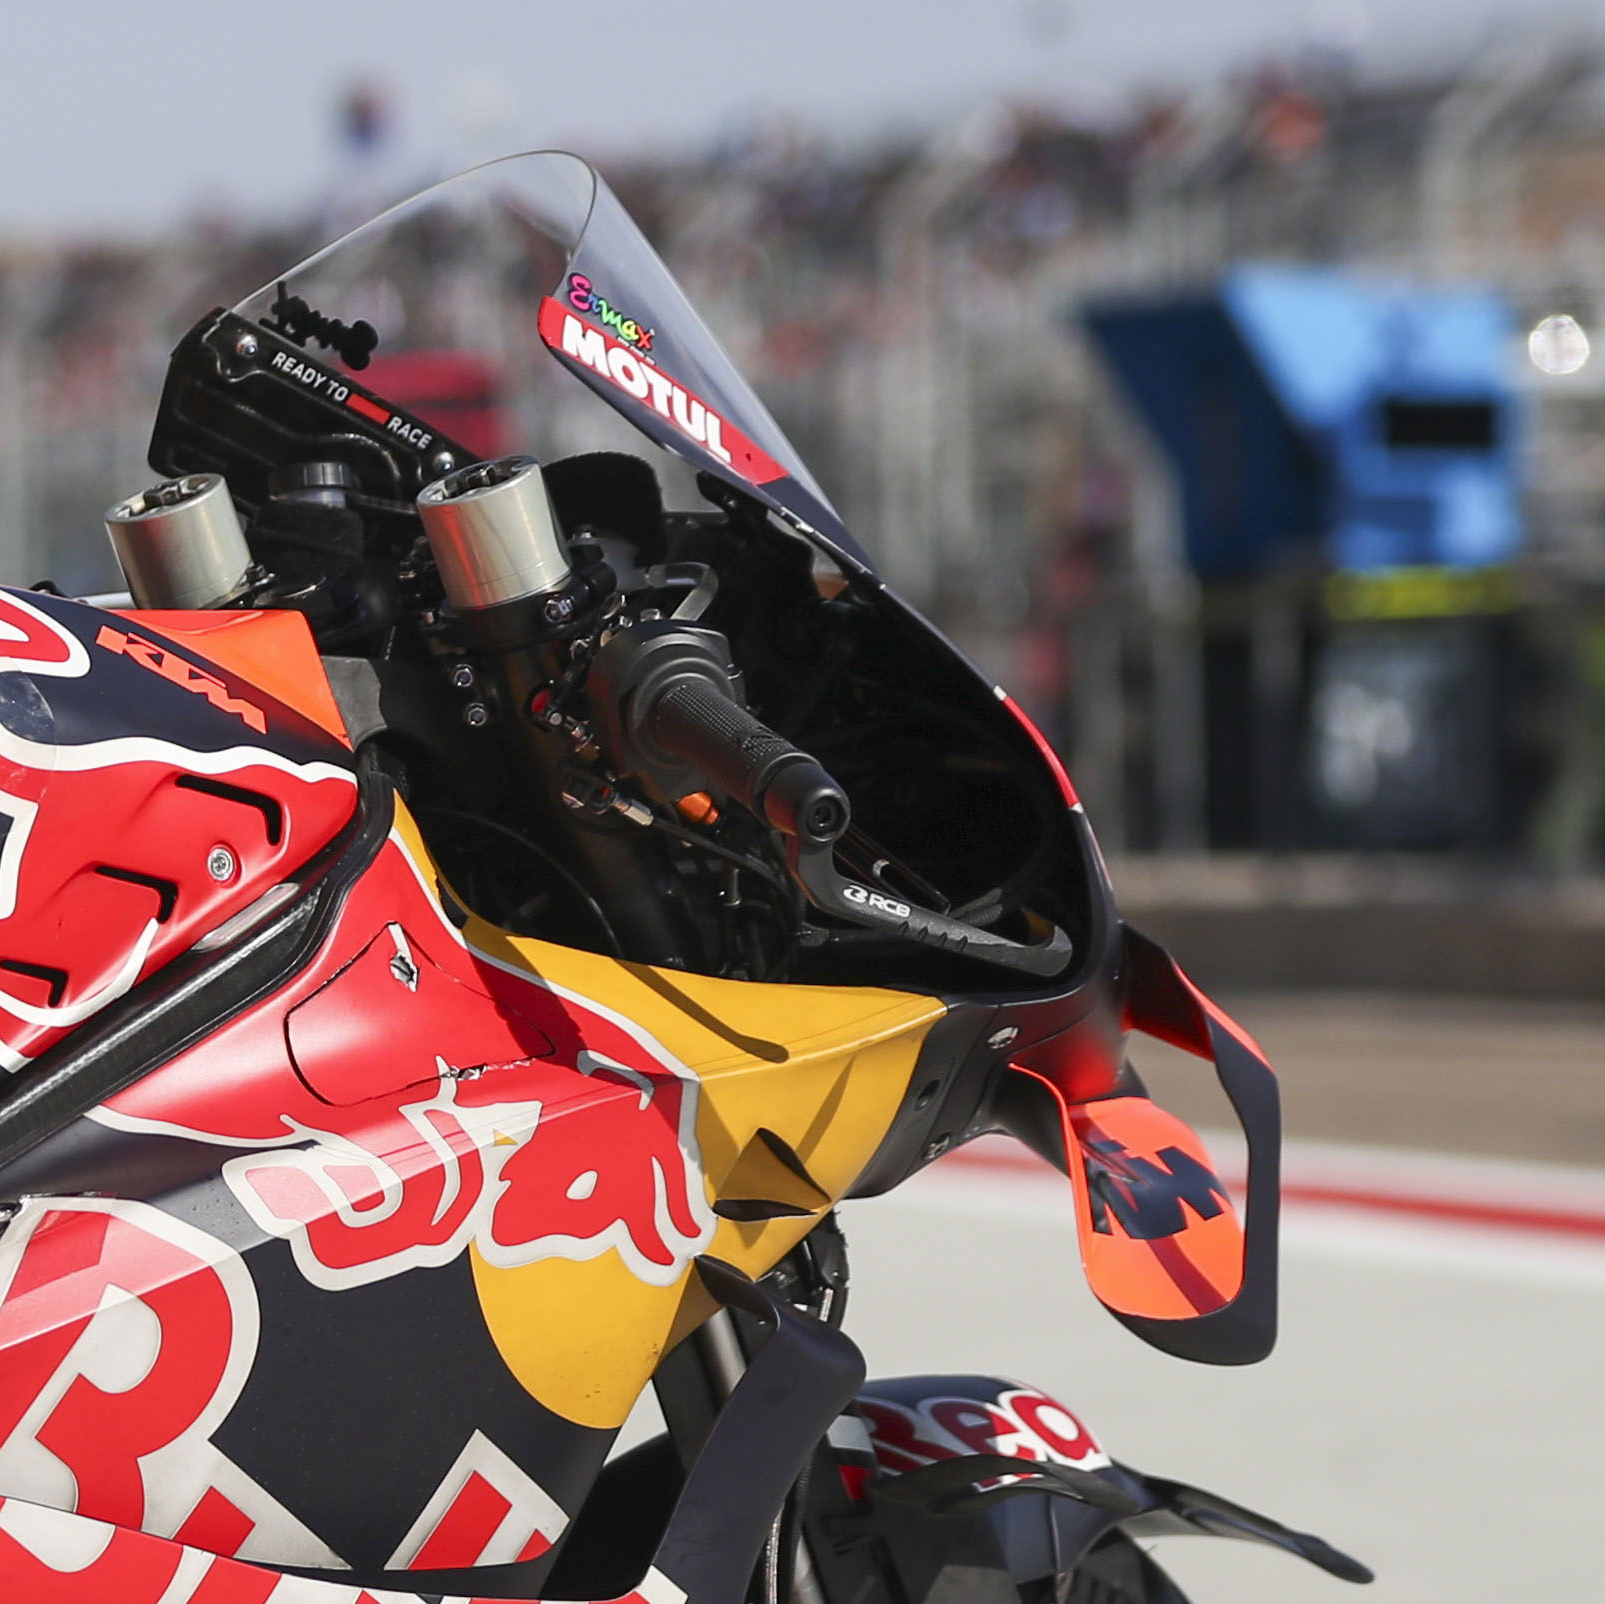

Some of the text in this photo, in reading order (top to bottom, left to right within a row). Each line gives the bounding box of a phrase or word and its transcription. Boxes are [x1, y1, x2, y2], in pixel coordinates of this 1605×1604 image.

[567, 272, 652, 349] Ermax
[272, 351, 433, 450] READY TO RACE
[562, 314, 732, 464] MOTUL
[95, 624, 267, 735] KTM
[868, 893, 911, 917] RCB
